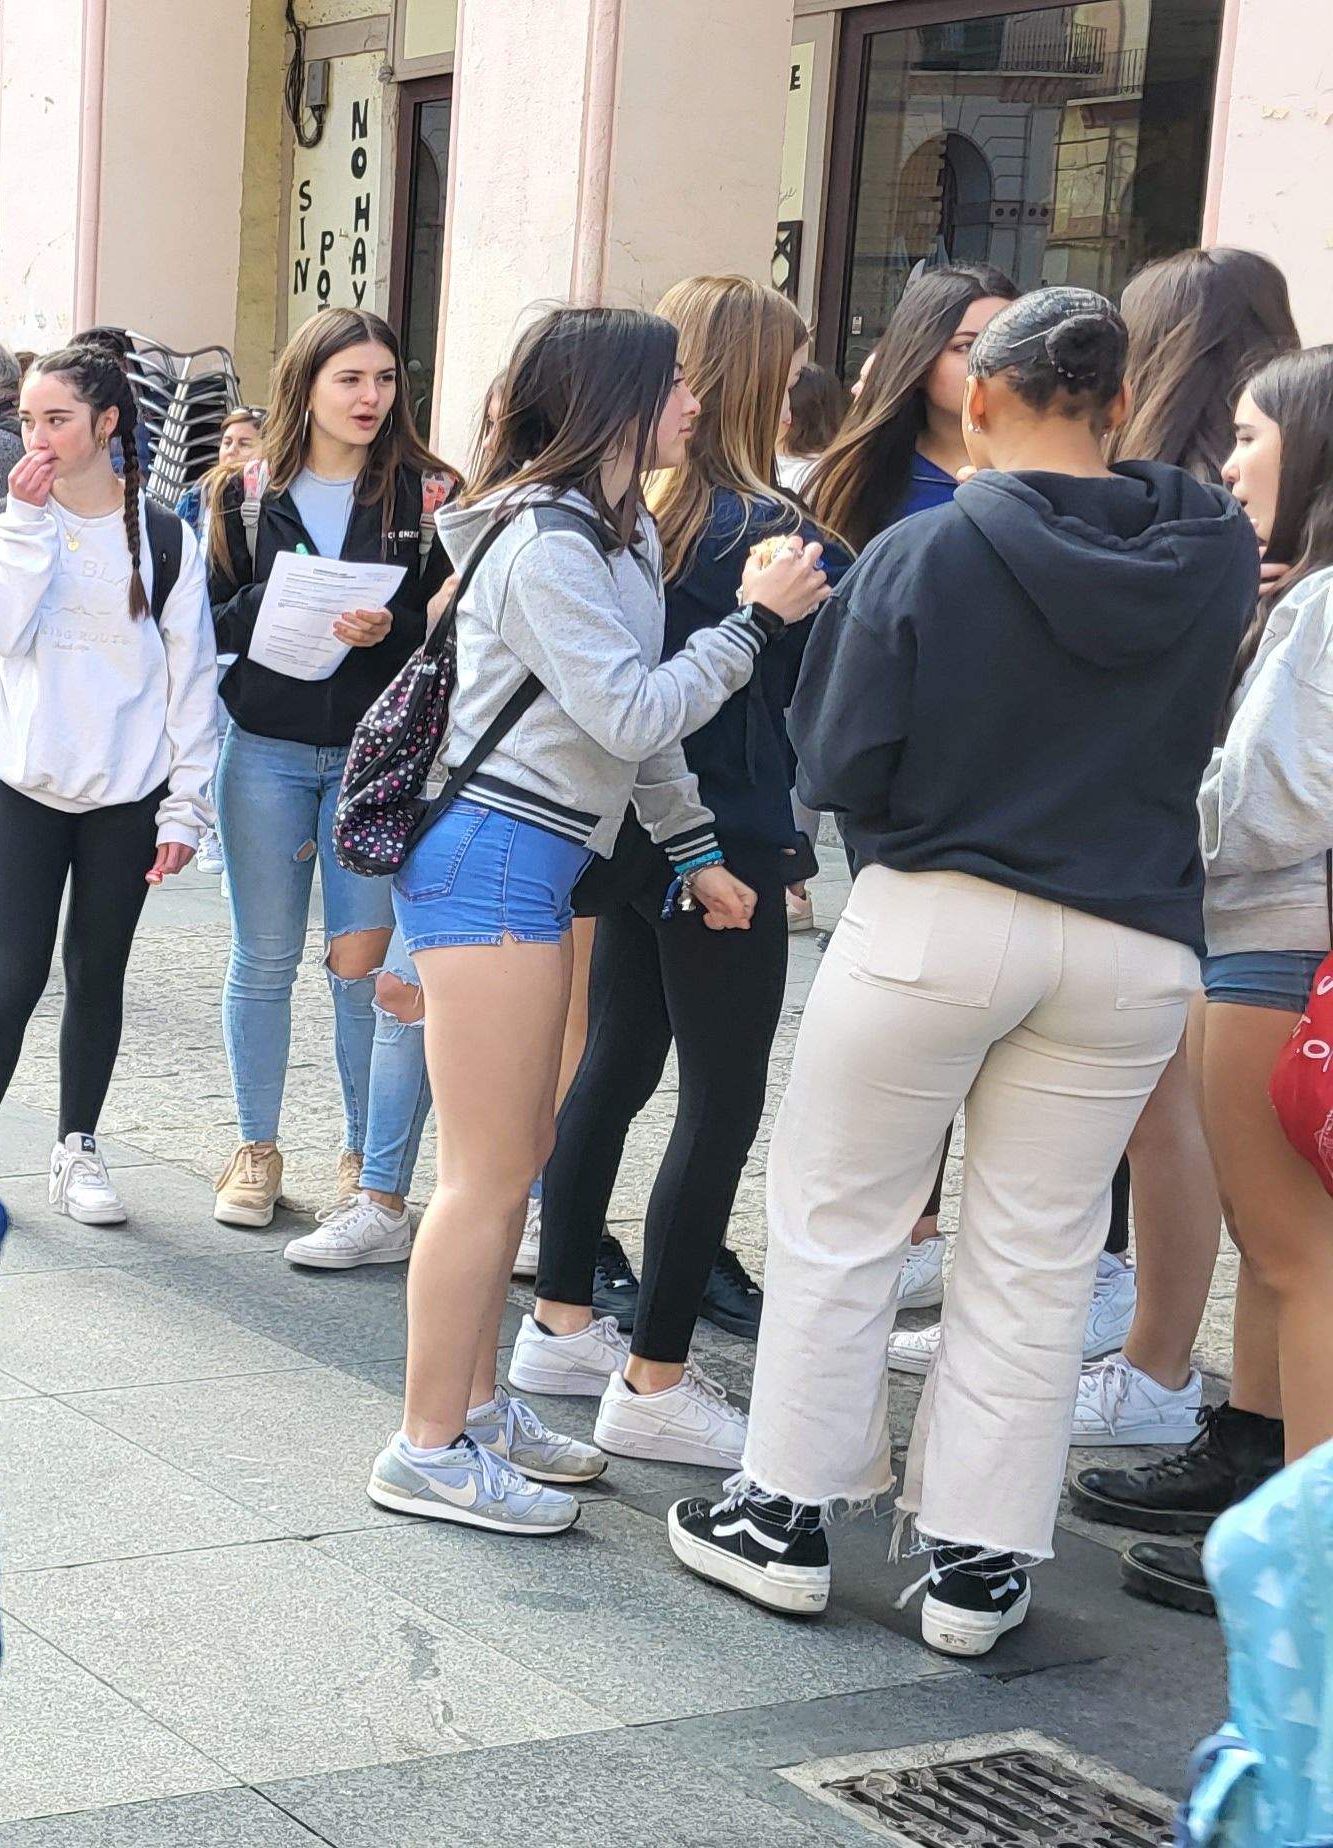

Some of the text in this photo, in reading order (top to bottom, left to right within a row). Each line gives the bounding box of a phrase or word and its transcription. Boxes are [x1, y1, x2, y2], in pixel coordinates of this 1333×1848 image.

[294, 179, 312, 295] SIN
[351, 98, 370, 308] NO HAY
